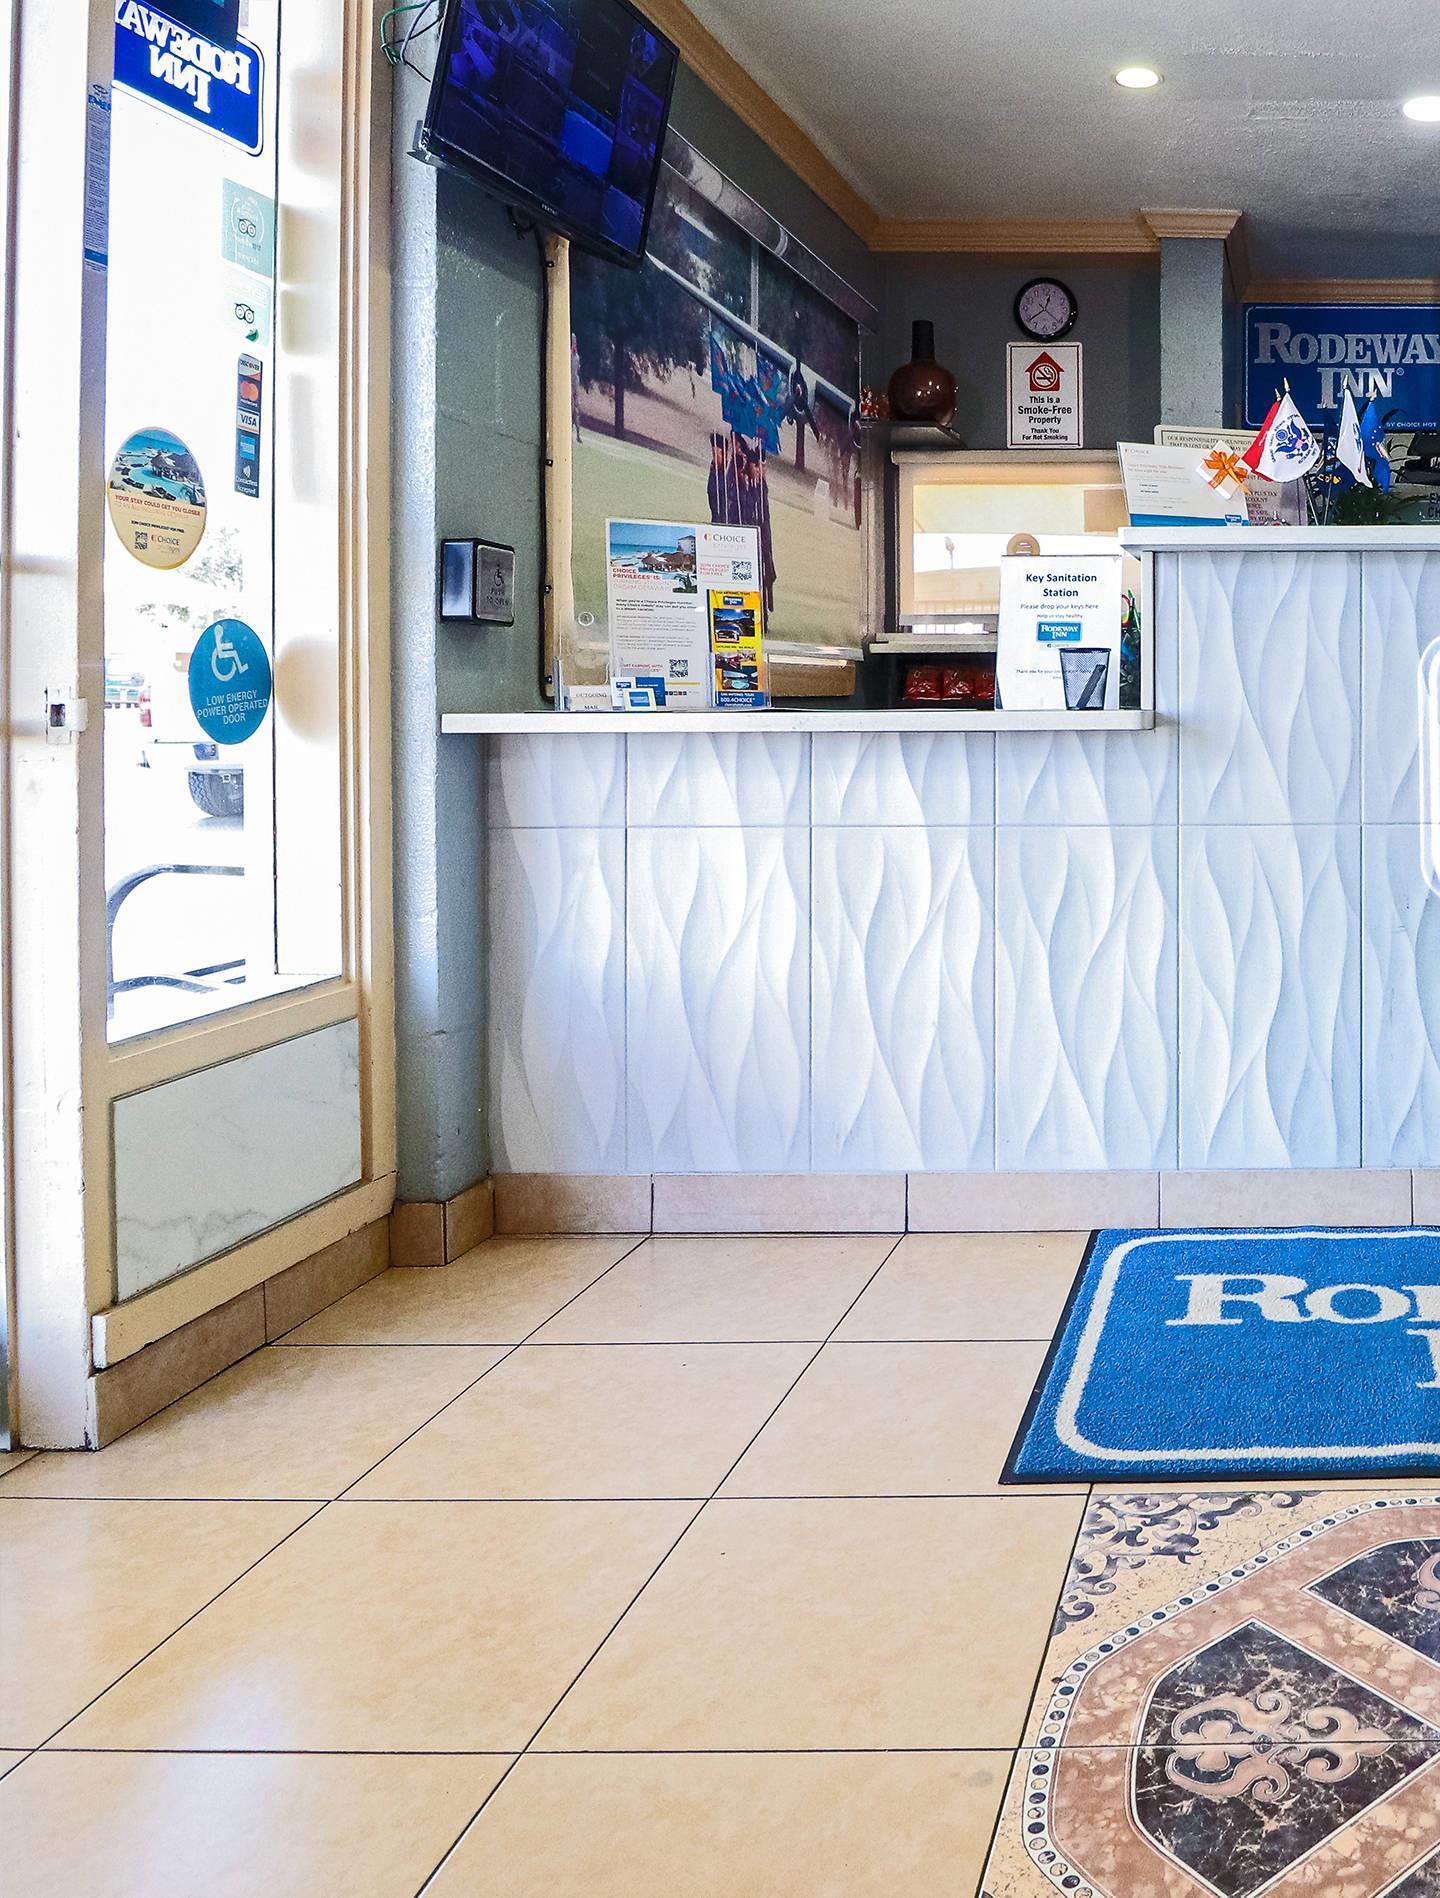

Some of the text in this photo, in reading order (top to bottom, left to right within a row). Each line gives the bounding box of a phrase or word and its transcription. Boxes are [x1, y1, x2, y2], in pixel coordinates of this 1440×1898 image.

[1316, 367, 1395, 410] INN
[1029, 396, 1045, 404] This
[1047, 396, 1054, 404] is
[1017, 405, 1073, 415] Smoke-Free
[240, 415, 257, 427] VISA
[1028, 415, 1062, 425] Property
[1044, 434, 1068, 442] Smoking
[115, 494, 129, 502] YOUR
[143, 500, 160, 509] COULD
[157, 535, 180, 546] CHOICE
[713, 533, 746, 543] CHOICE
[1026, 573, 1097, 584] Key Sanitation
[1043, 587, 1079, 597] Station
[1040, 603, 1055, 611] drop
[1070, 603, 1084, 611] keys
[1040, 625, 1079, 633] RODEWAY
[1052, 631, 1068, 639] INN
[206, 689, 258, 706] LOW ENERGY
[197, 698, 268, 719] POWER OPERATED
[223, 713, 246, 725] DOOR
